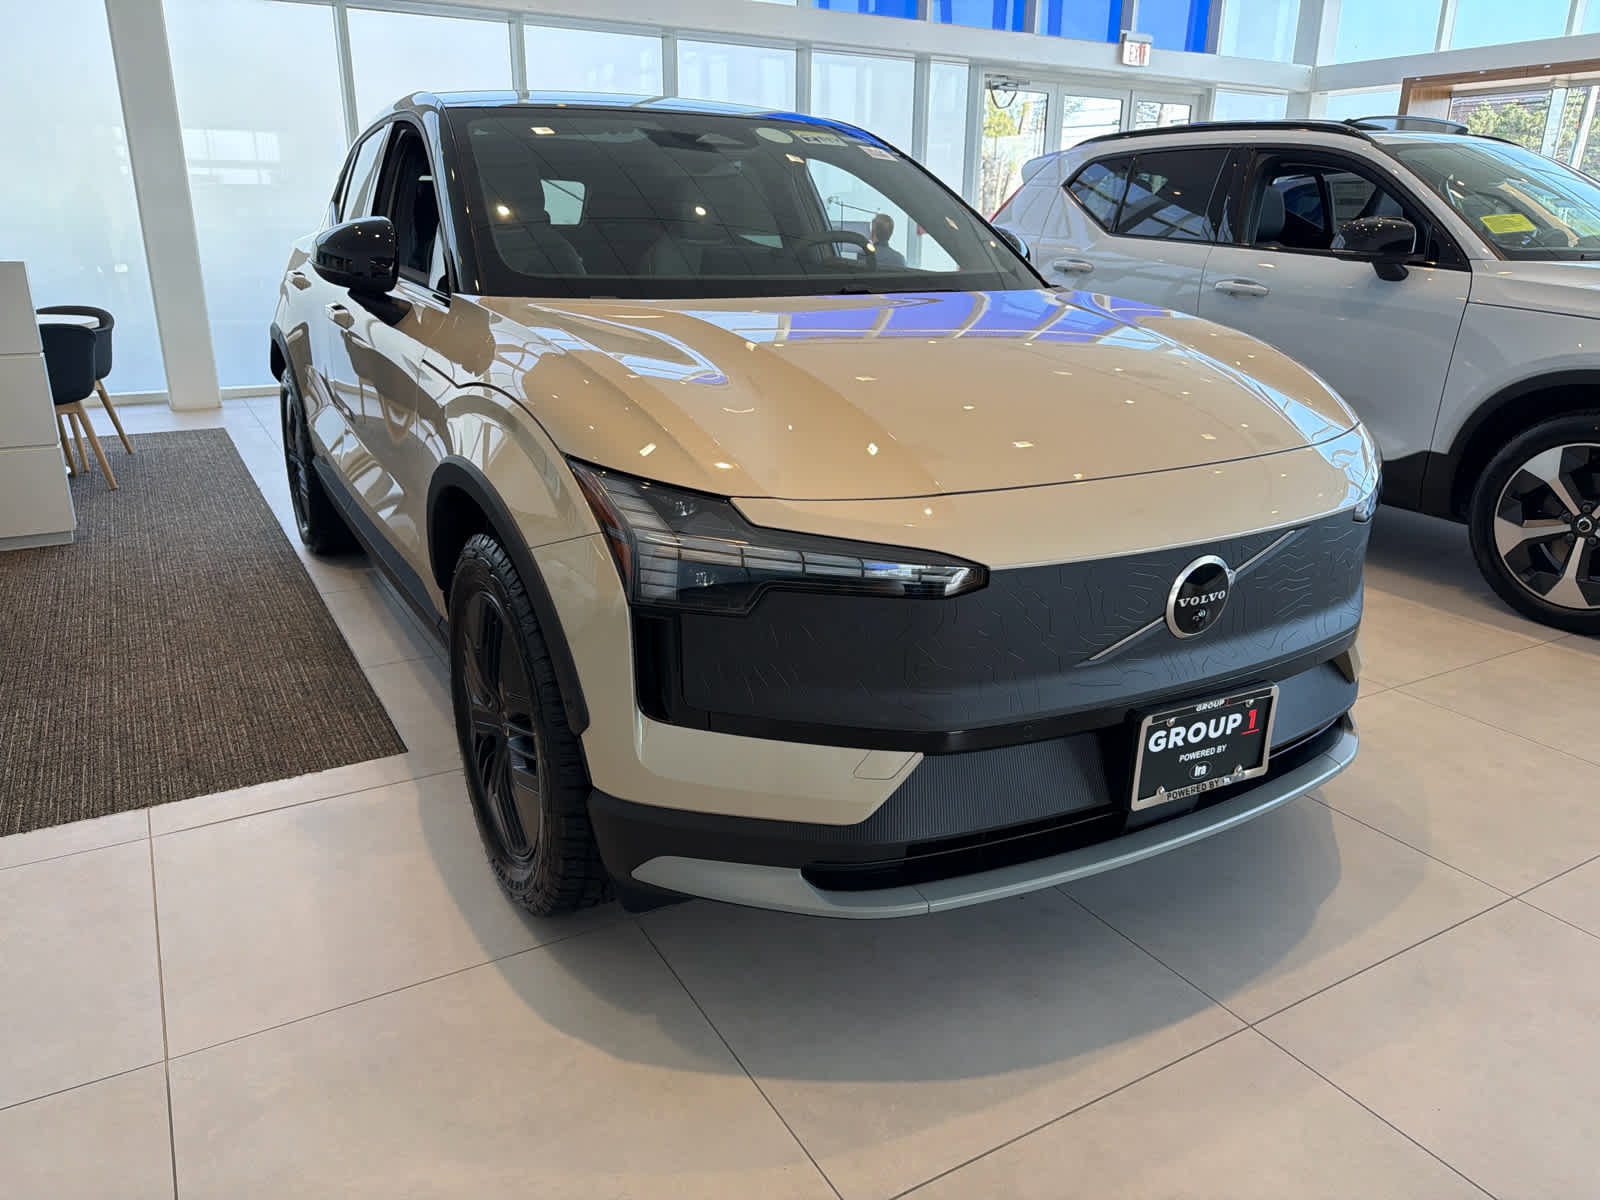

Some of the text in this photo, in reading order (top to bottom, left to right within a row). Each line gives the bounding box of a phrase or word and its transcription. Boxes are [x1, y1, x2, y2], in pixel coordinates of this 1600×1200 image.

[1128, 44, 1146, 64] EXIT
[1178, 590, 1226, 608] VOLVO
[1196, 698, 1225, 712] GROUP
[1148, 709, 1259, 753] GROUP 1
[1179, 744, 1228, 763] POWERED BY
[1166, 782, 1208, 801] POWERED
[1208, 779, 1220, 790] BY
